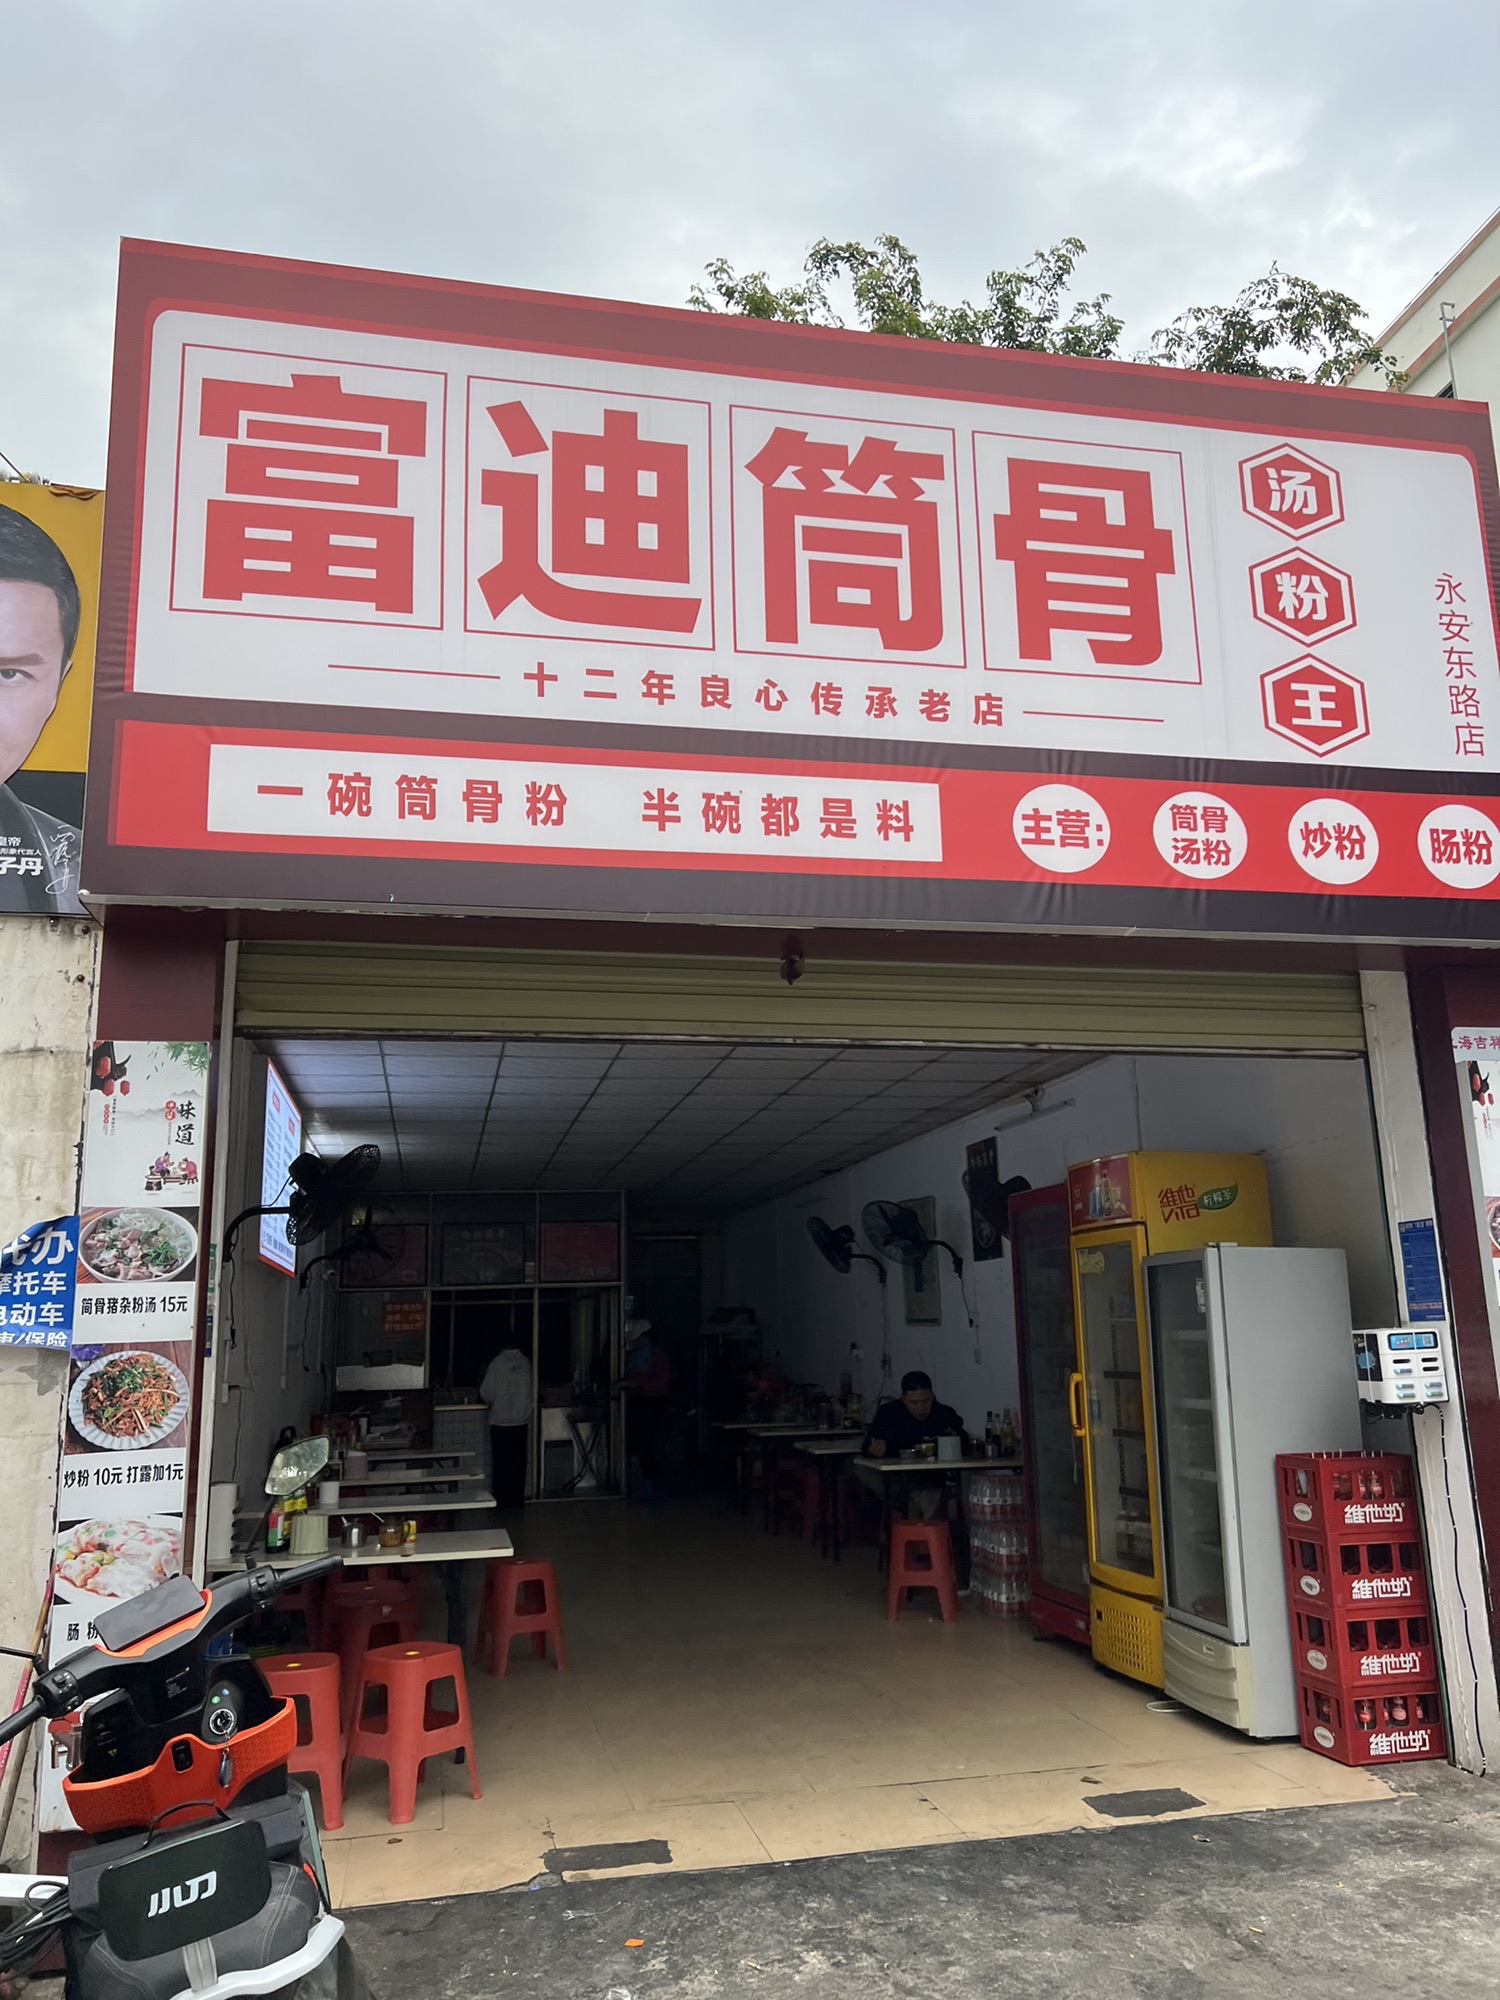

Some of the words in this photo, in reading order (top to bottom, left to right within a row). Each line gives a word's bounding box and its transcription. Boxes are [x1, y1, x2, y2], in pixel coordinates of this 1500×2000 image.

[199, 373, 1176, 667] 富迪筒骨
[1266, 466, 1343, 728] 汤粉王
[1434, 572, 1485, 758] 永安东路店
[522, 661, 1005, 728] 十二年良心传承老店
[256, 771, 568, 828] 一碗筒骨粉
[640, 786, 914, 843] 半碗都是料
[1169, 803, 1229, 834] 筒骨
[1171, 836, 1233, 868] 汤粉
[1299, 820, 1367, 861] 炒粉
[1428, 826, 1494, 866] 肠粉
[174, 1099, 196, 1146] 味道
[0, 1301, 65, 1327] 动车
[159, 1295, 189, 1313] 15元
[63, 1469, 90, 1489] 炒粉
[93, 1466, 123, 1486] 10元
